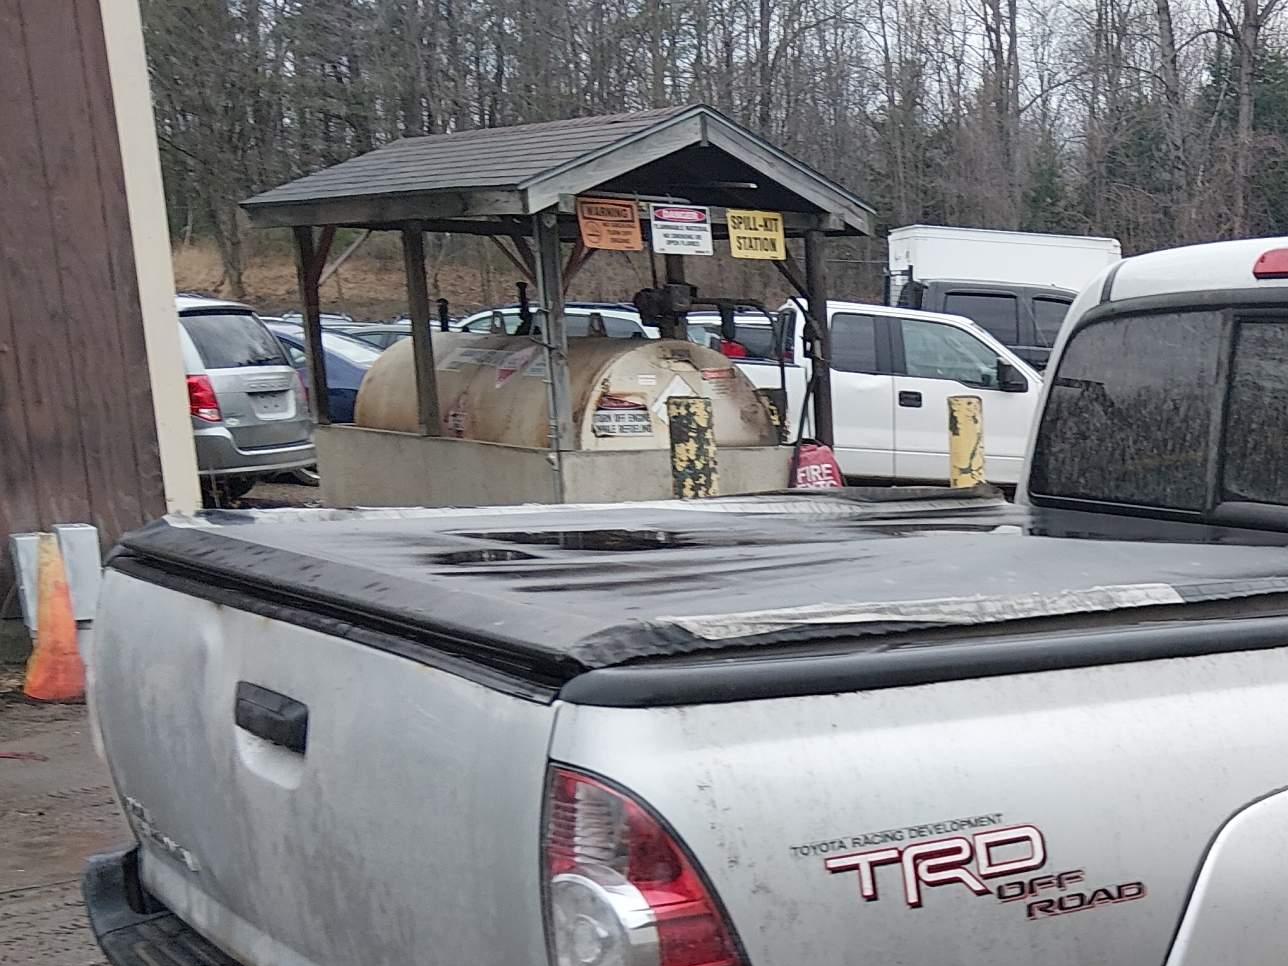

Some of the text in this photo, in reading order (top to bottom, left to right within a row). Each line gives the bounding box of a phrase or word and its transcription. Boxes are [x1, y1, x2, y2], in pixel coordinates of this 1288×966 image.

[586, 206, 629, 218] WARNING
[662, 210, 698, 219] DANGER
[731, 215, 779, 232] SPILL-KIT
[736, 235, 777, 252] STATION
[797, 463, 834, 483] FIRE
[789, 812, 1004, 858] TOYOTA RACING DEVELOPMENT
[824, 823, 1048, 909] TRD
[995, 868, 1087, 904] OFF
[1025, 880, 1149, 921] ROAD
